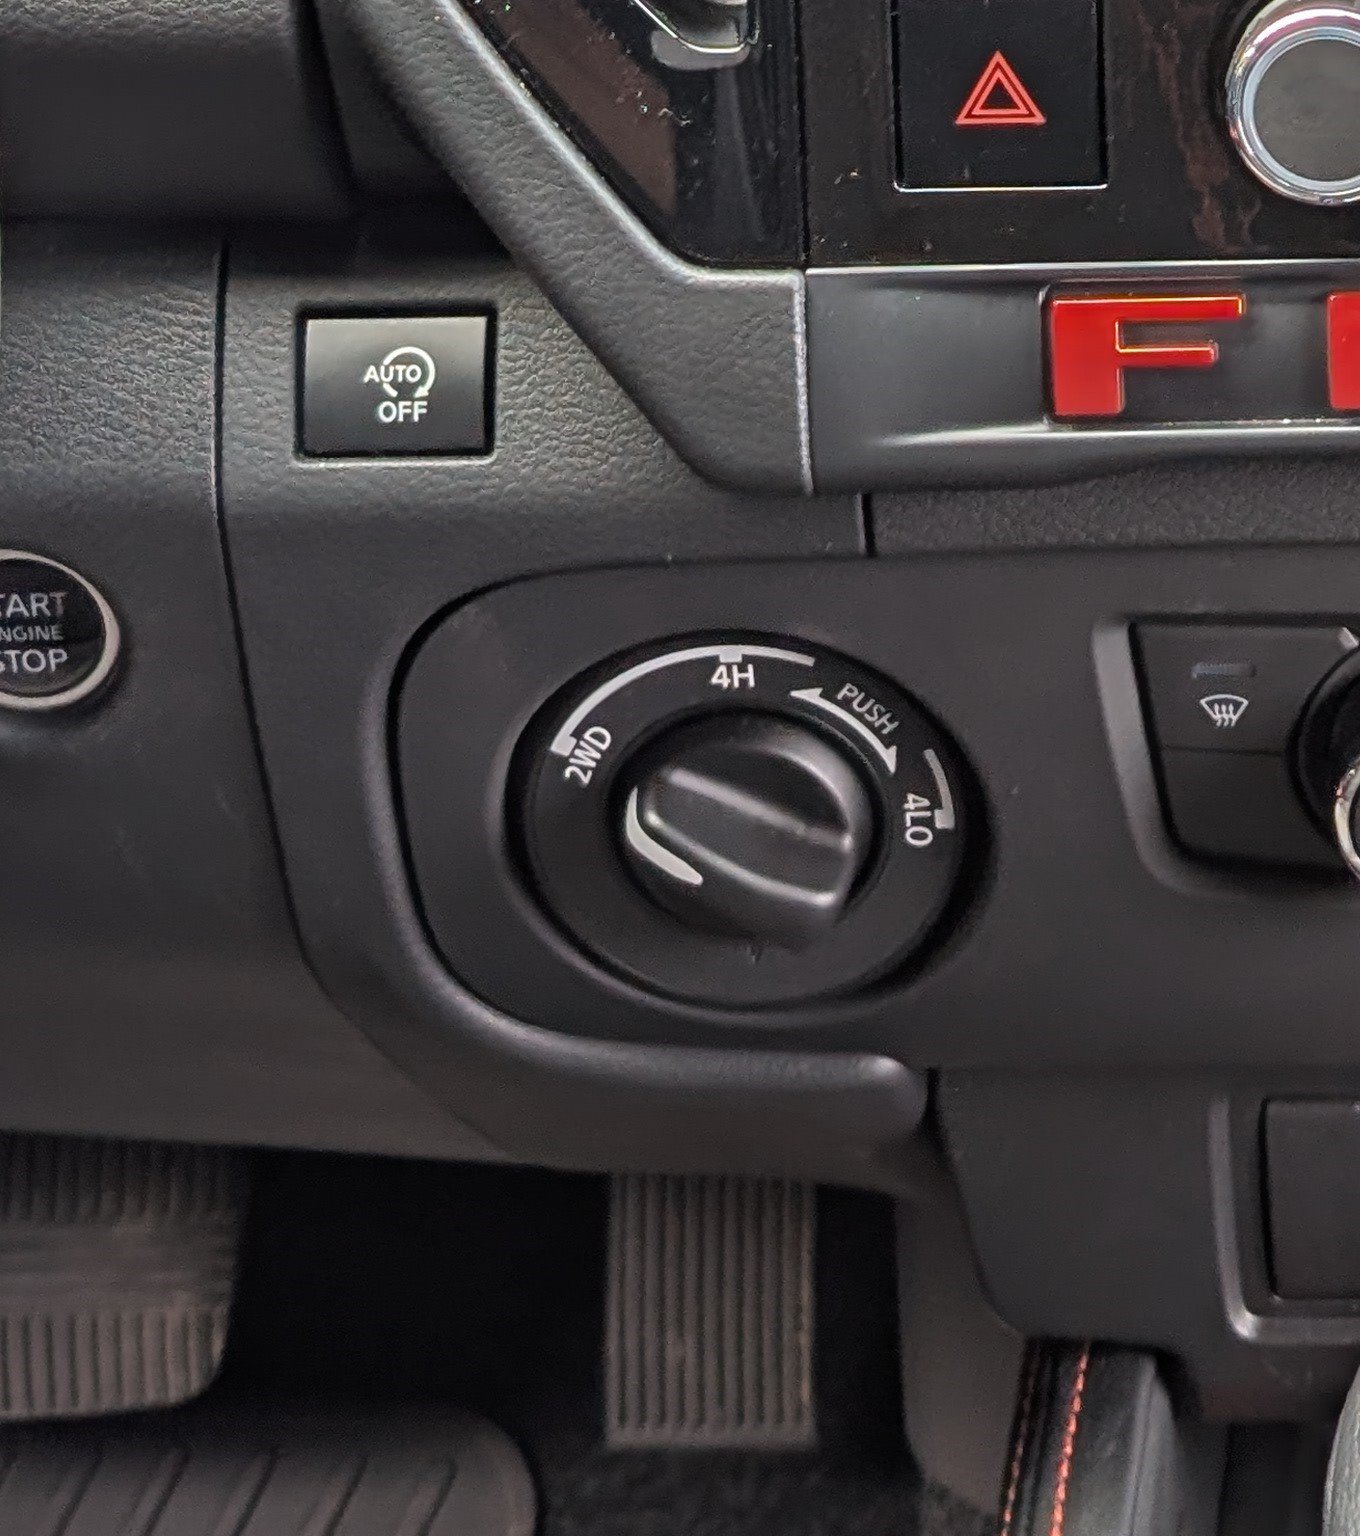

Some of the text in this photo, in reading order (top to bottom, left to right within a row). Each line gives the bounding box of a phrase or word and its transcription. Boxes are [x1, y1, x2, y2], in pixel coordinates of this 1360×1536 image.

[363, 364, 423, 384] AUTO
[377, 400, 428, 423] OFF
[709, 662, 756, 690] 4H
[835, 680, 900, 736] PUSH
[563, 724, 614, 787] 2WD
[902, 791, 935, 848] 4LO
